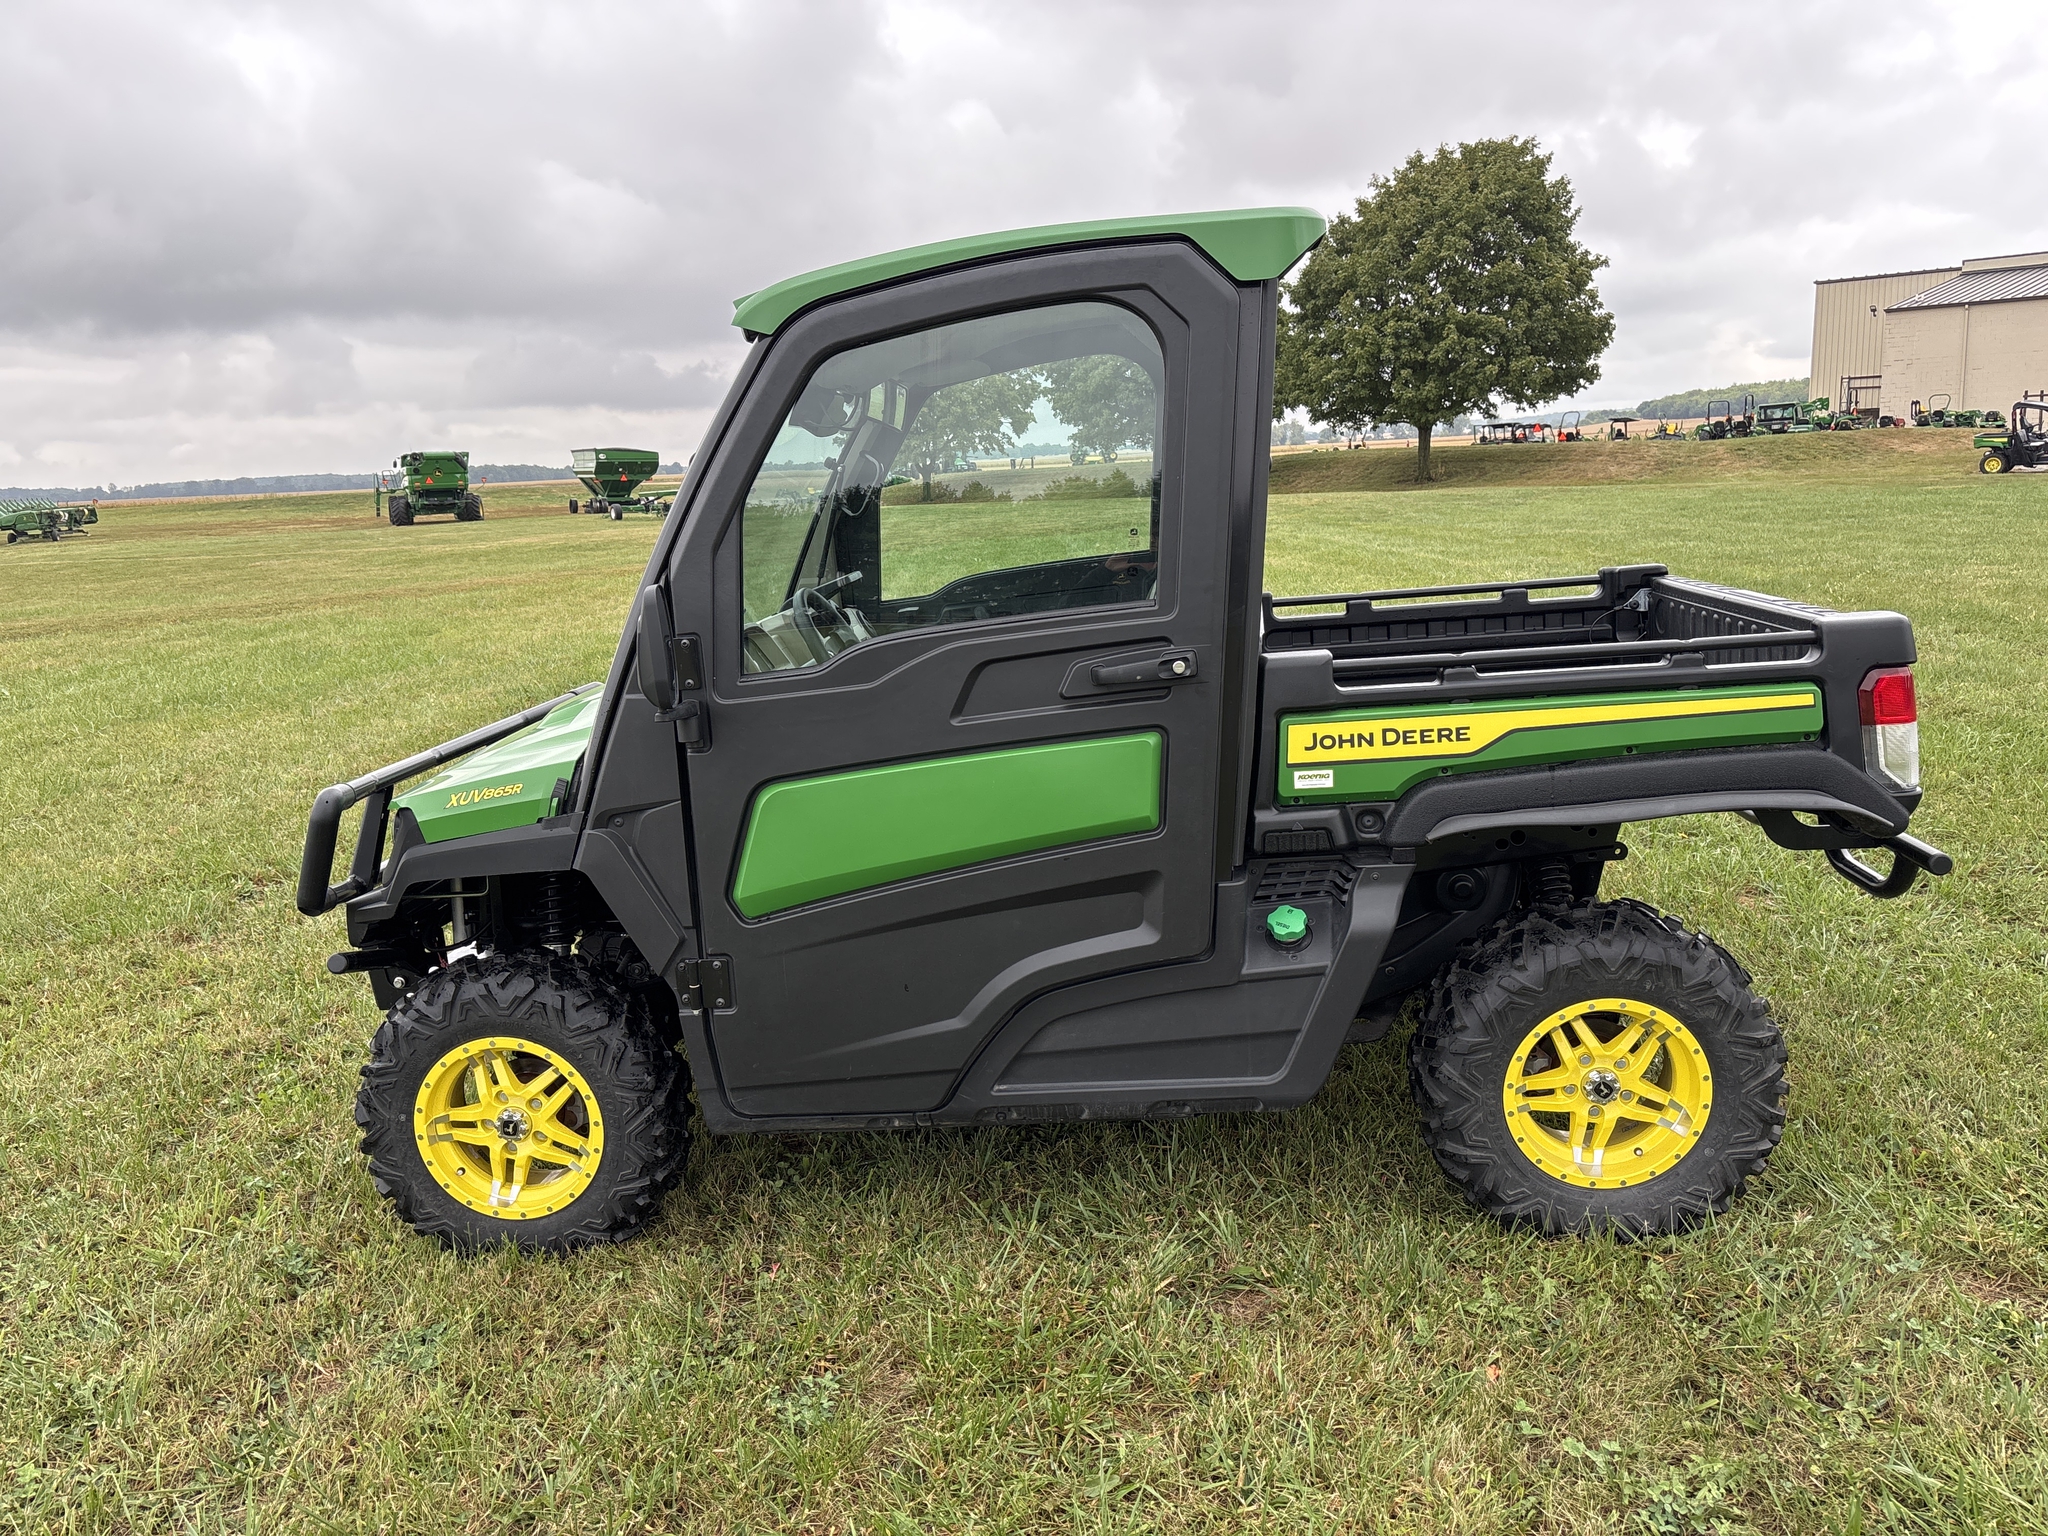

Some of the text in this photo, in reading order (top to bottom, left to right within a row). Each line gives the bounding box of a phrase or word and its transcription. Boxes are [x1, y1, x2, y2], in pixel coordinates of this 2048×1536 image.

[1304, 726, 1471, 751] JOHN DEERE
[443, 783, 524, 809] XUV865R
